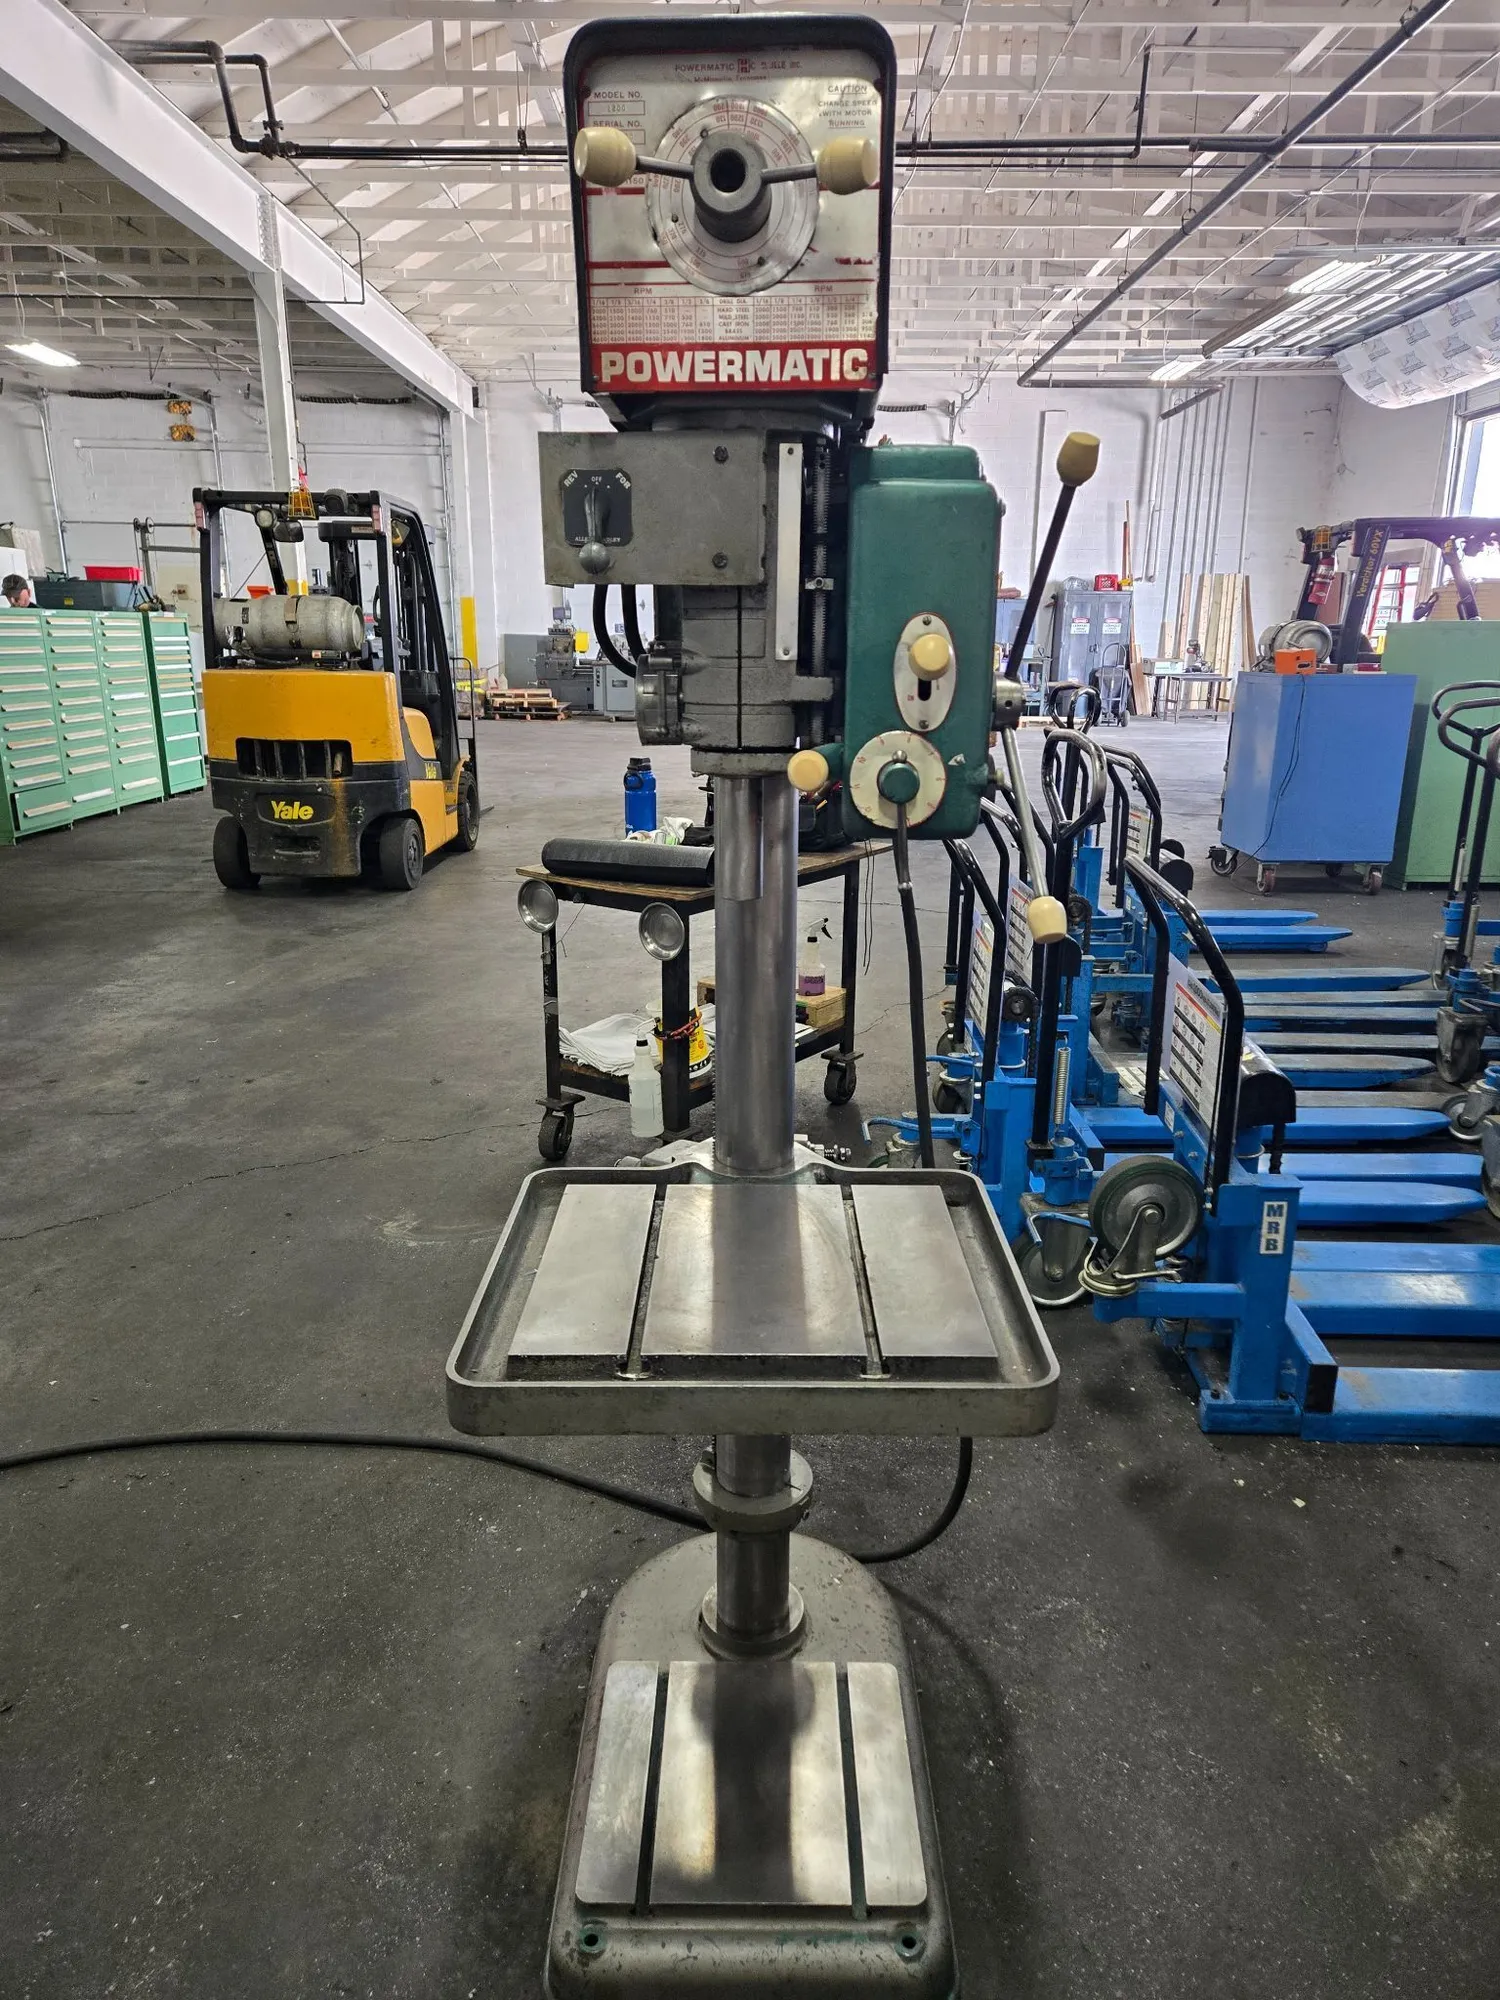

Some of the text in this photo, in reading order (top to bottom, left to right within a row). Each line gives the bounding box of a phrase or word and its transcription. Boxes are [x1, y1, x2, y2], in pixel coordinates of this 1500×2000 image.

[601, 349, 868, 383] POWERMATIC
[564, 470, 578, 487] REV
[615, 472, 631, 489] FOR
[1370, 529, 1384, 555] 60VX
[271, 800, 314, 820] Yale
